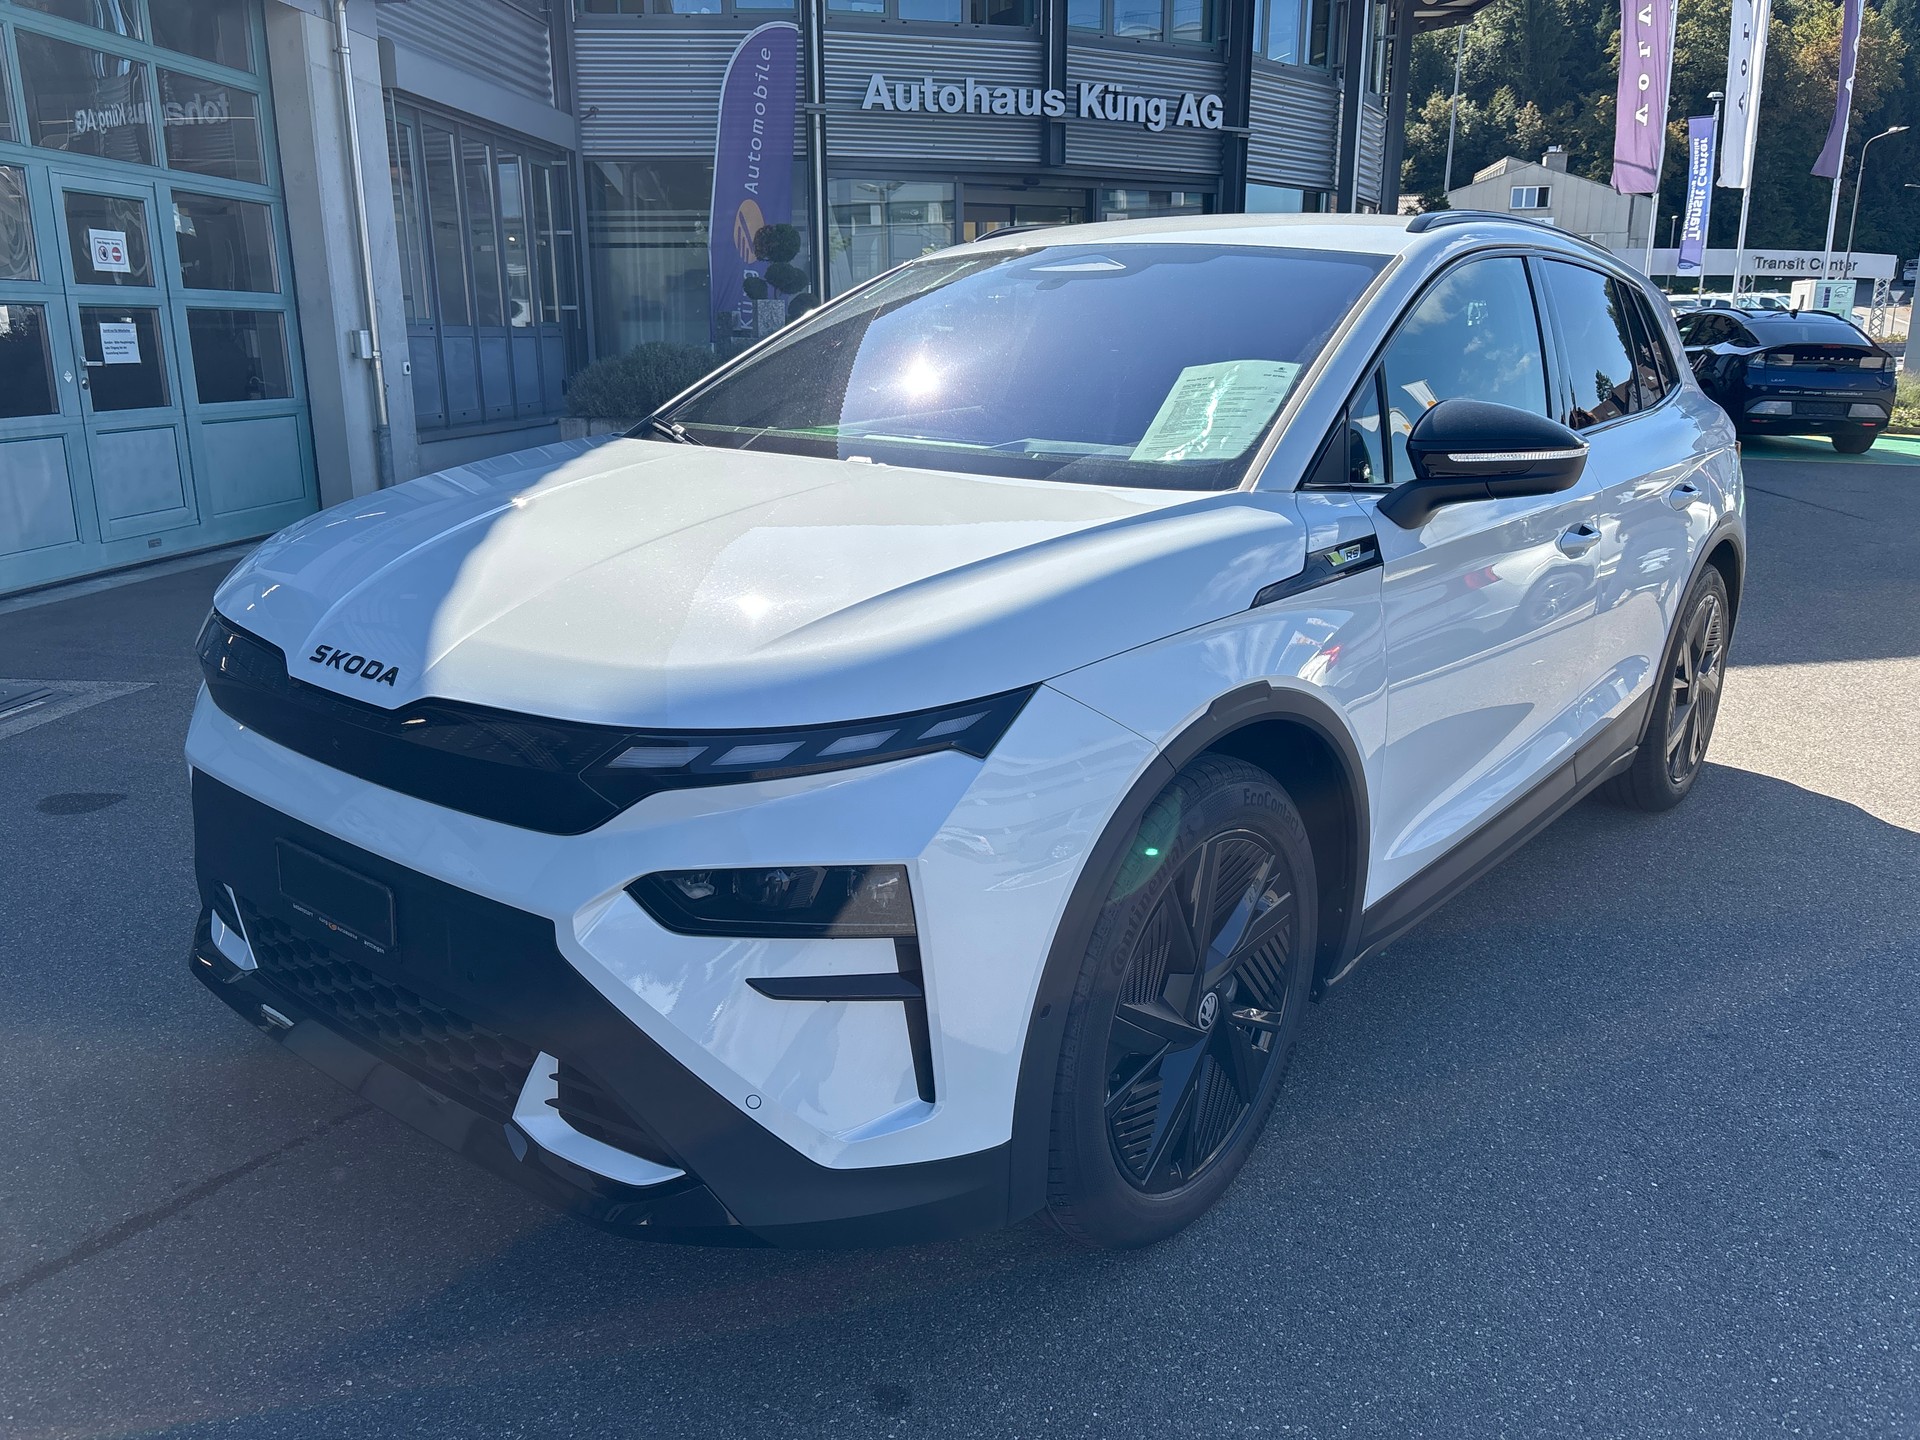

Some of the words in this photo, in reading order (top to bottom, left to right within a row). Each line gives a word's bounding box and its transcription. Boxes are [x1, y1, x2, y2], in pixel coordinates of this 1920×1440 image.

[744, 47, 772, 195] Automobile
[861, 73, 1067, 118] Autohaus
[1079, 82, 1168, 133] Küng
[1176, 92, 1225, 130] AG
[1754, 256, 1805, 271] Transit
[738, 269, 760, 330] Küg
